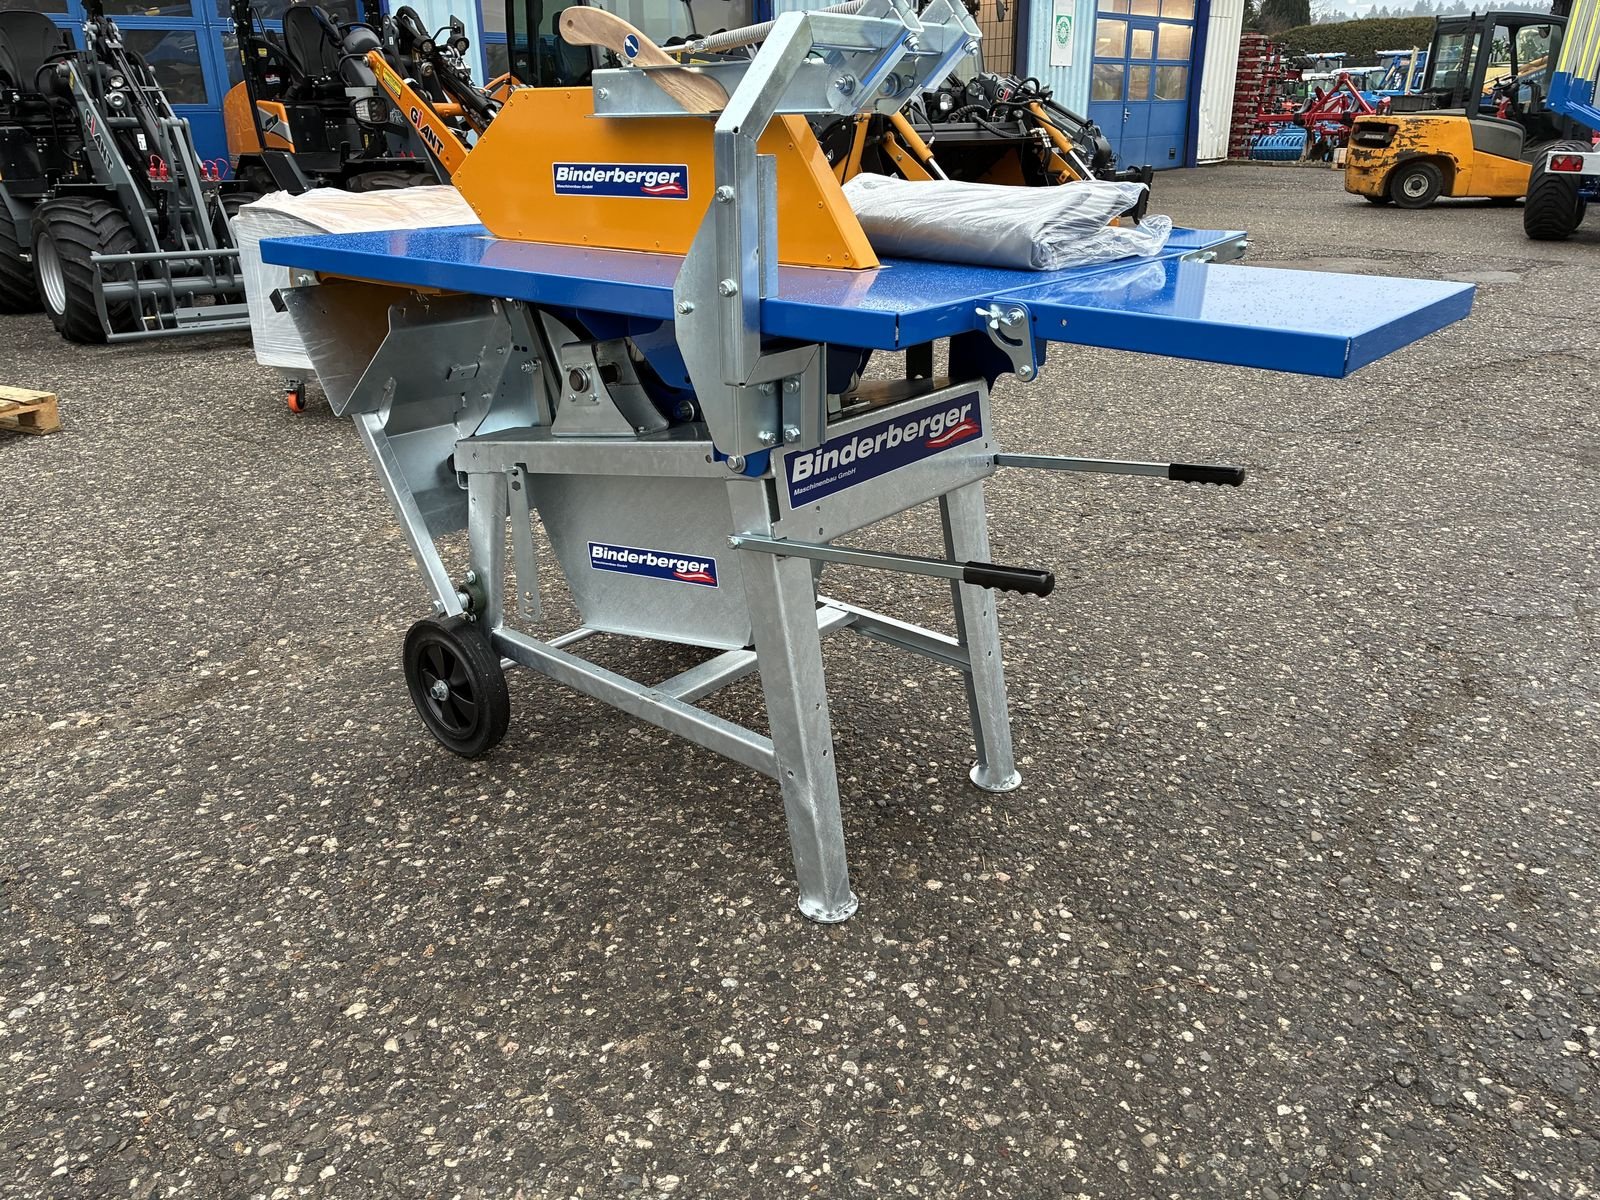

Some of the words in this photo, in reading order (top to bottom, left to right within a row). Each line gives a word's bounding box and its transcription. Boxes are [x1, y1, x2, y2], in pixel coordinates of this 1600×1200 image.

[556, 166, 680, 187] Binderberger
[791, 402, 972, 483] Binderberger
[793, 475, 838, 496] Maschinenbau
[838, 467, 857, 479] GmbH
[592, 545, 709, 573] Binderberger
